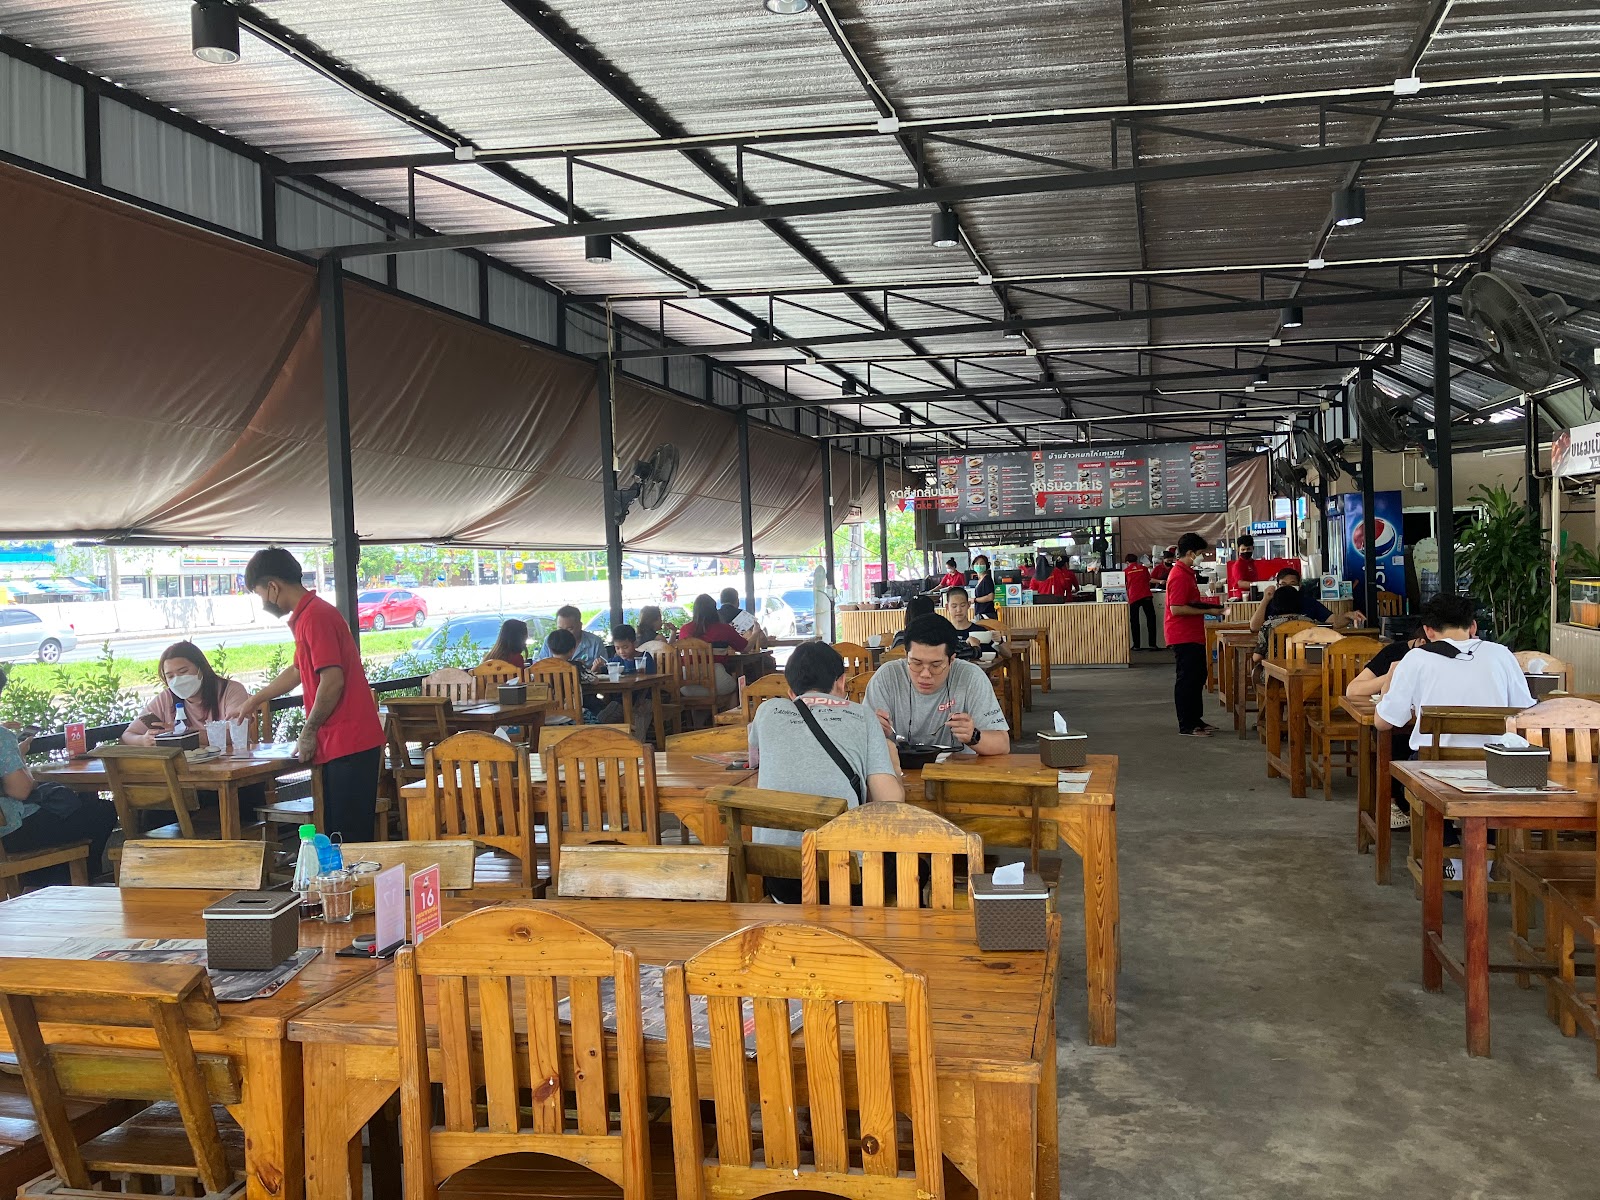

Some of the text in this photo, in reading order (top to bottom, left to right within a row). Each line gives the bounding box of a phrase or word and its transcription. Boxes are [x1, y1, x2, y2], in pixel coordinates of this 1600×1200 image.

[1030, 478, 1103, 497] จุดรับอาหาร
[1067, 495, 1103, 508] Pick up
[71, 732, 81, 741] 26
[420, 888, 435, 910] 16
